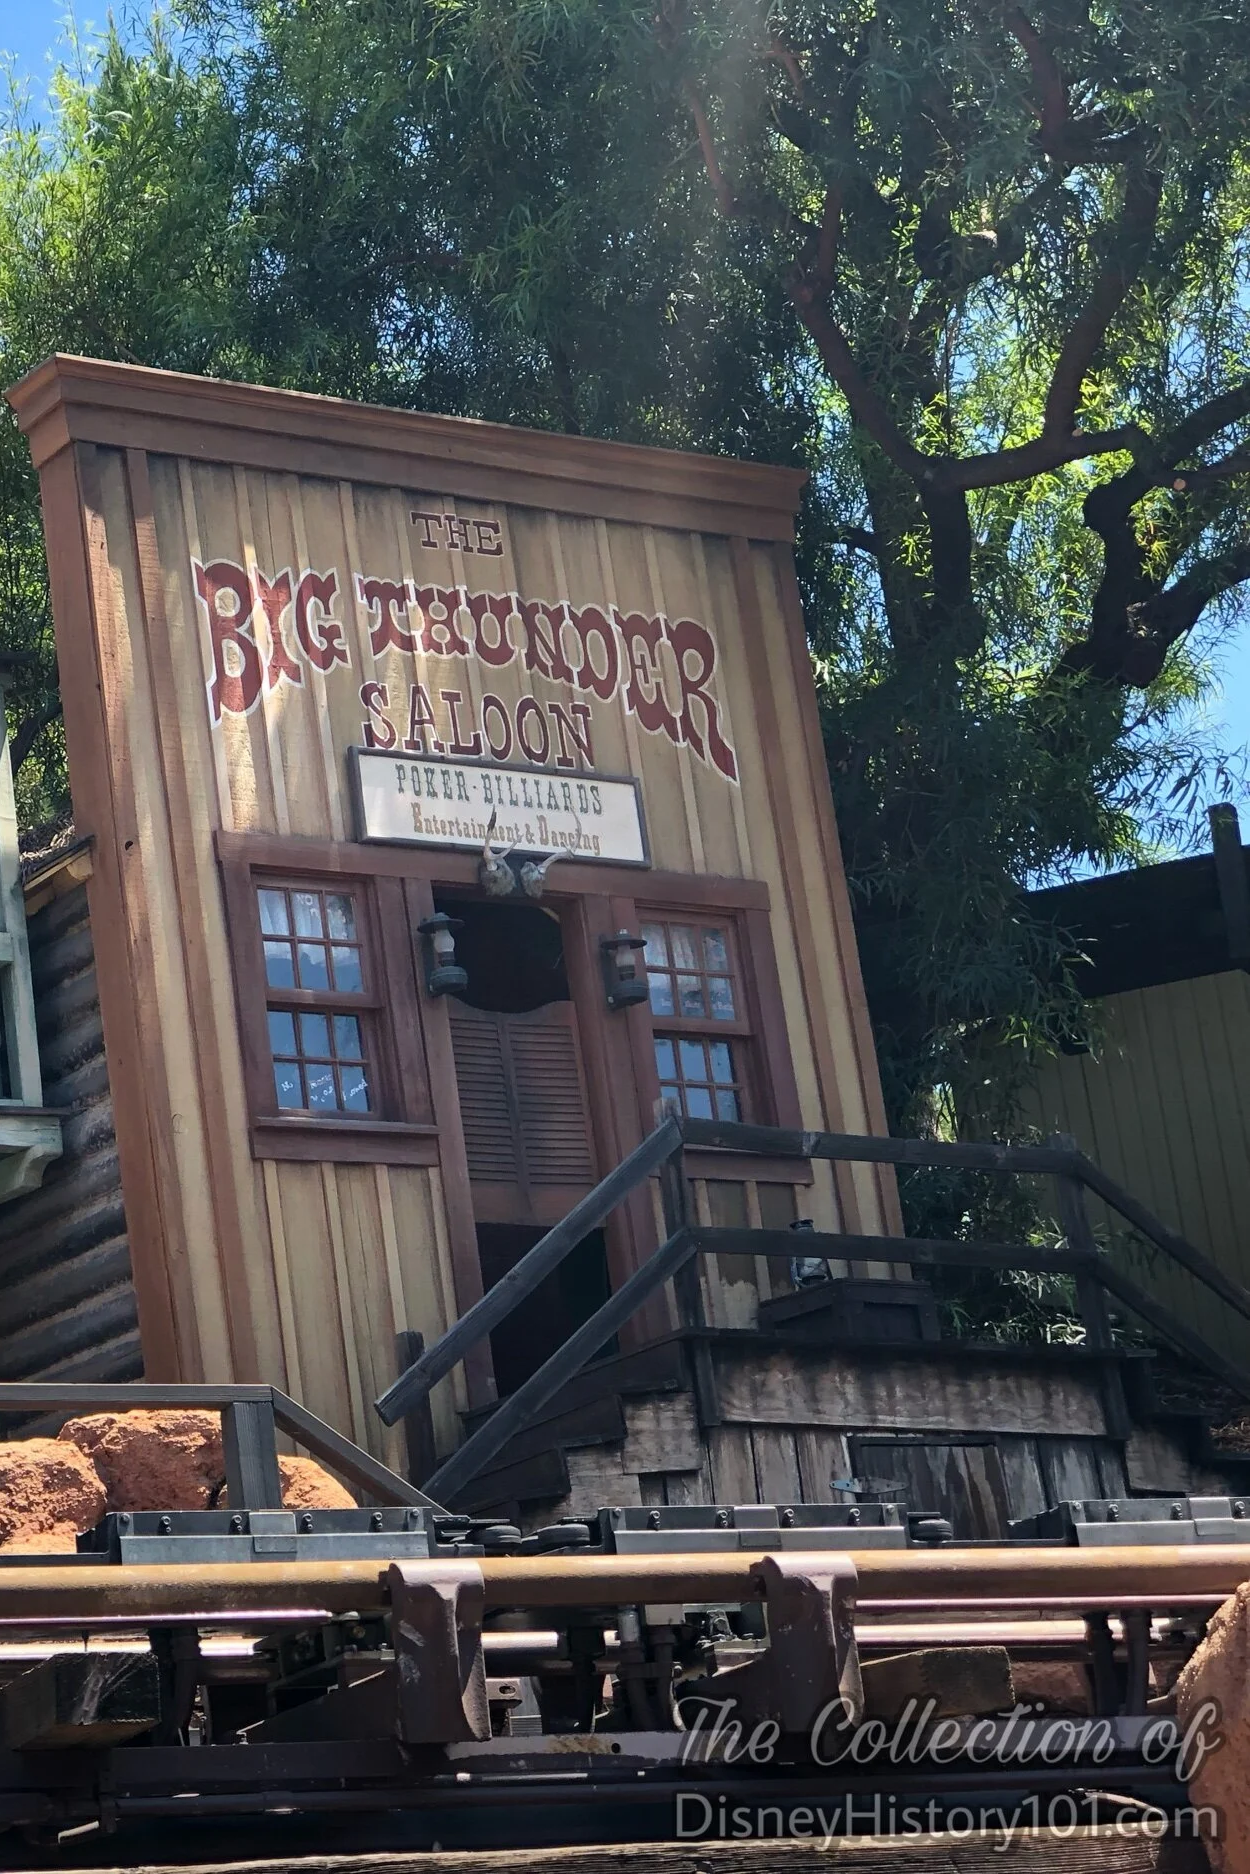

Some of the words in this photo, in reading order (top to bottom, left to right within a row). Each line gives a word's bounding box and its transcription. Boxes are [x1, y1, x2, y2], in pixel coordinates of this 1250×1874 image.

[410, 510, 504, 557] THE
[191, 557, 352, 728] BIG
[354, 572, 739, 785] THUNDER
[359, 681, 595, 768] SALOON
[395, 764, 470, 802] POKER
[480, 772, 603, 815] BILLIARDS
[525, 823, 535, 844] &
